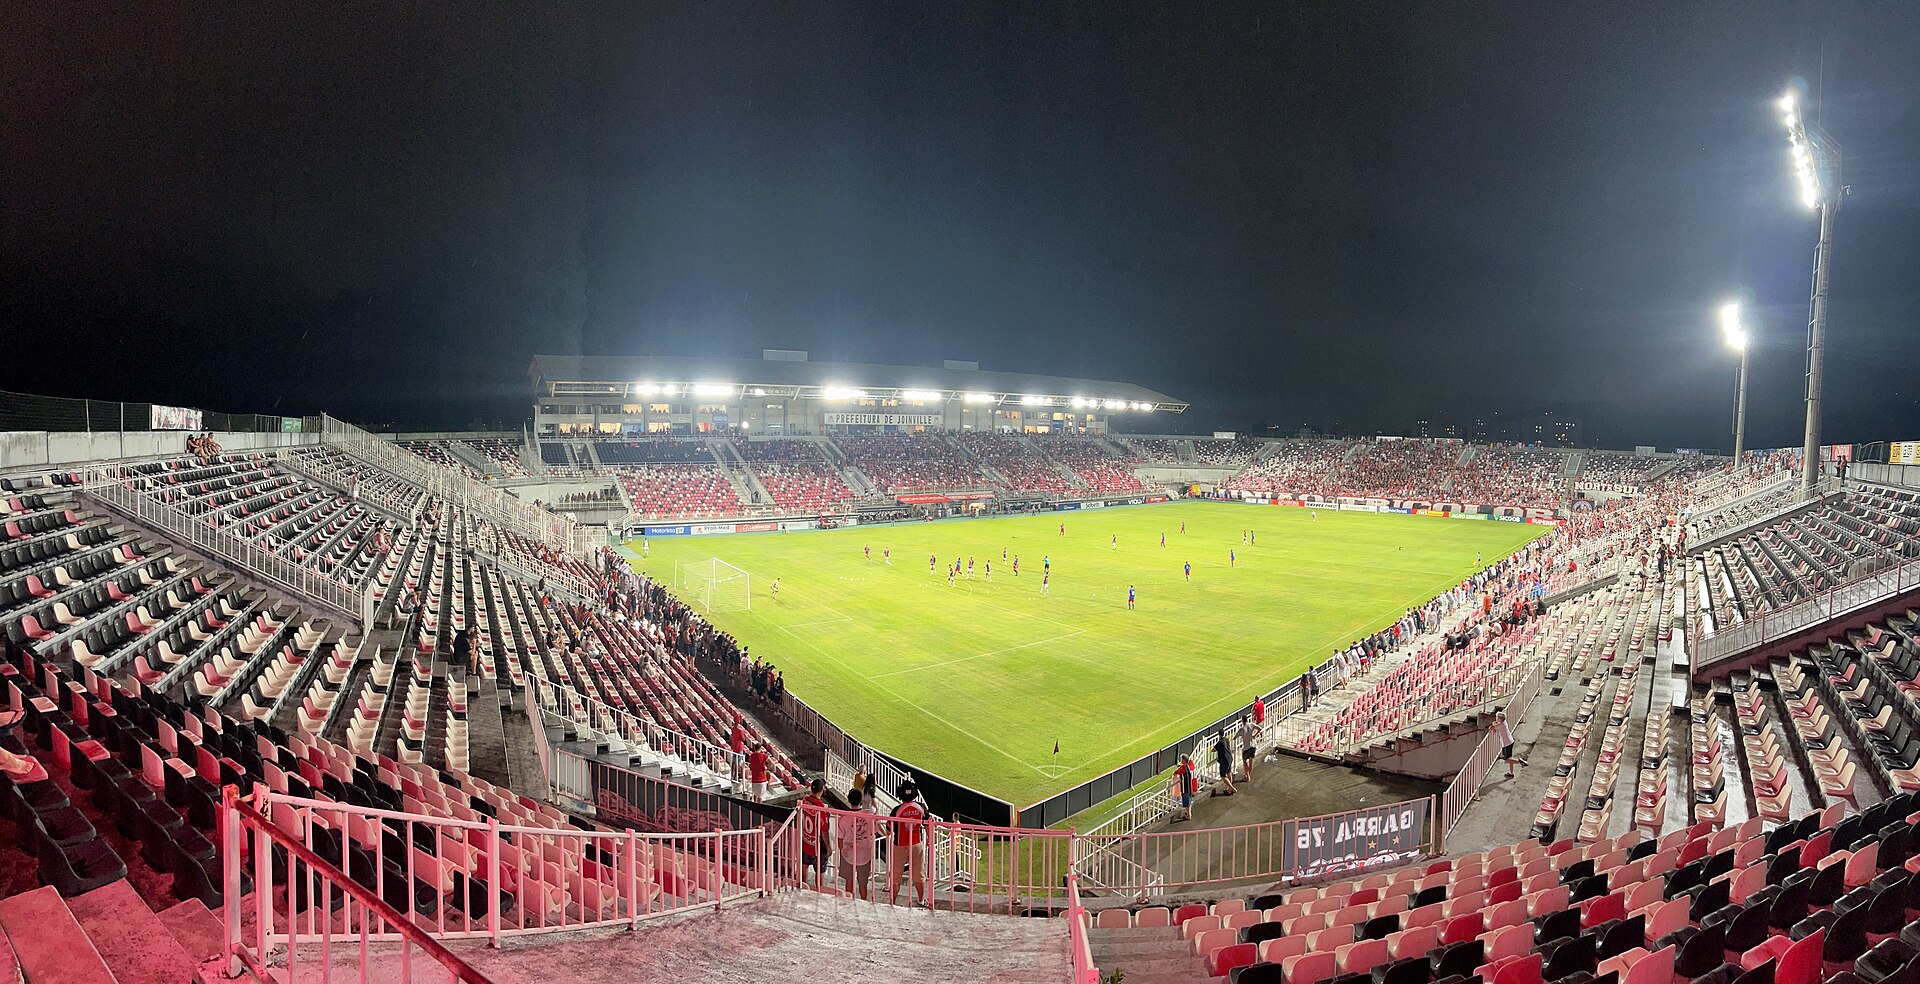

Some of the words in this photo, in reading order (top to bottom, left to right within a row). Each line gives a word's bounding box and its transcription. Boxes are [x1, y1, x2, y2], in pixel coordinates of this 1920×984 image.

[835, 414, 880, 424] PREFEITURA
[884, 415, 893, 424] DE
[897, 415, 932, 424] JOINVILLE
[1499, 514, 1521, 522] SICOOB
